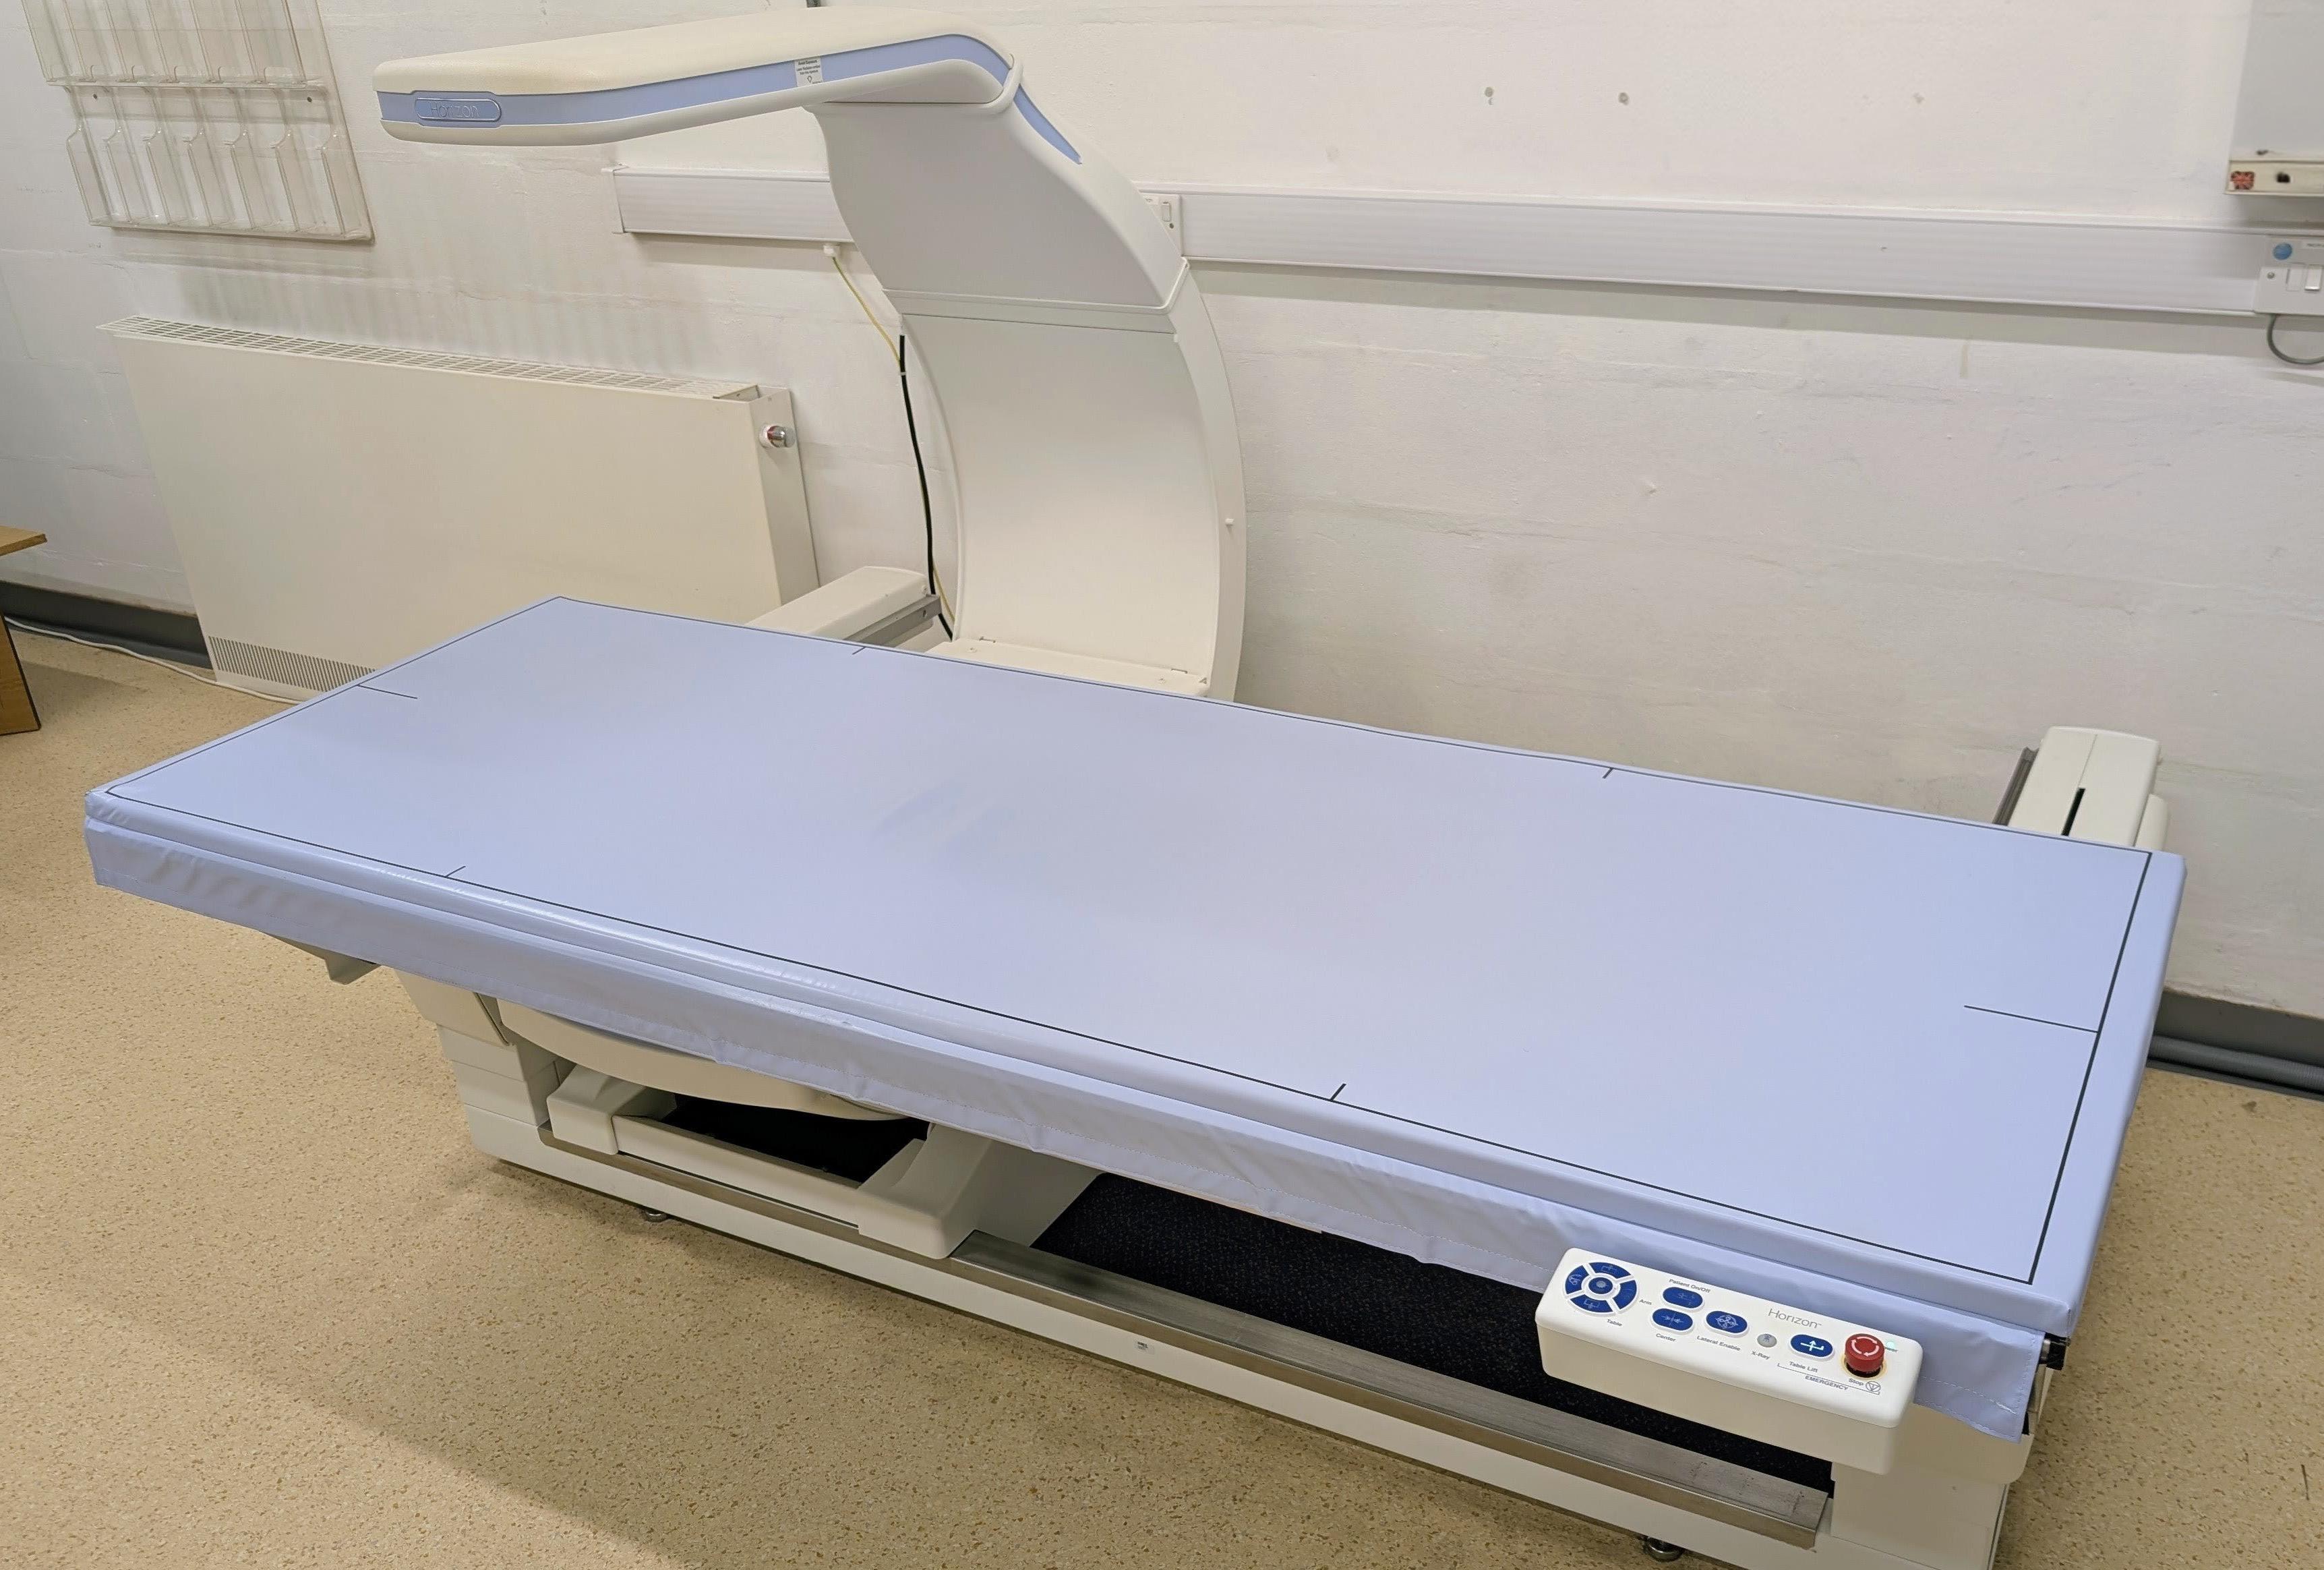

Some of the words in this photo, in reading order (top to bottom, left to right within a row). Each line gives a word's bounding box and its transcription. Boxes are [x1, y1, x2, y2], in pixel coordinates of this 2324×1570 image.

[1669, 1279, 1690, 1289] Patient
[1691, 1284, 1711, 1293] On/Off
[1607, 1318, 1622, 1327] Table
[1656, 1333, 1677, 1342] Center
[1696, 1335, 1719, 1345] Lateral
[1719, 1341, 1741, 1351] Enable
[1751, 1350, 1770, 1360] X-Ray
[1789, 1361, 1806, 1370] Table
[1808, 1364, 1818, 1373] Lift
[1805, 1375, 1849, 1391] EMERGENCY
[1849, 1378, 1864, 1386] Stop
